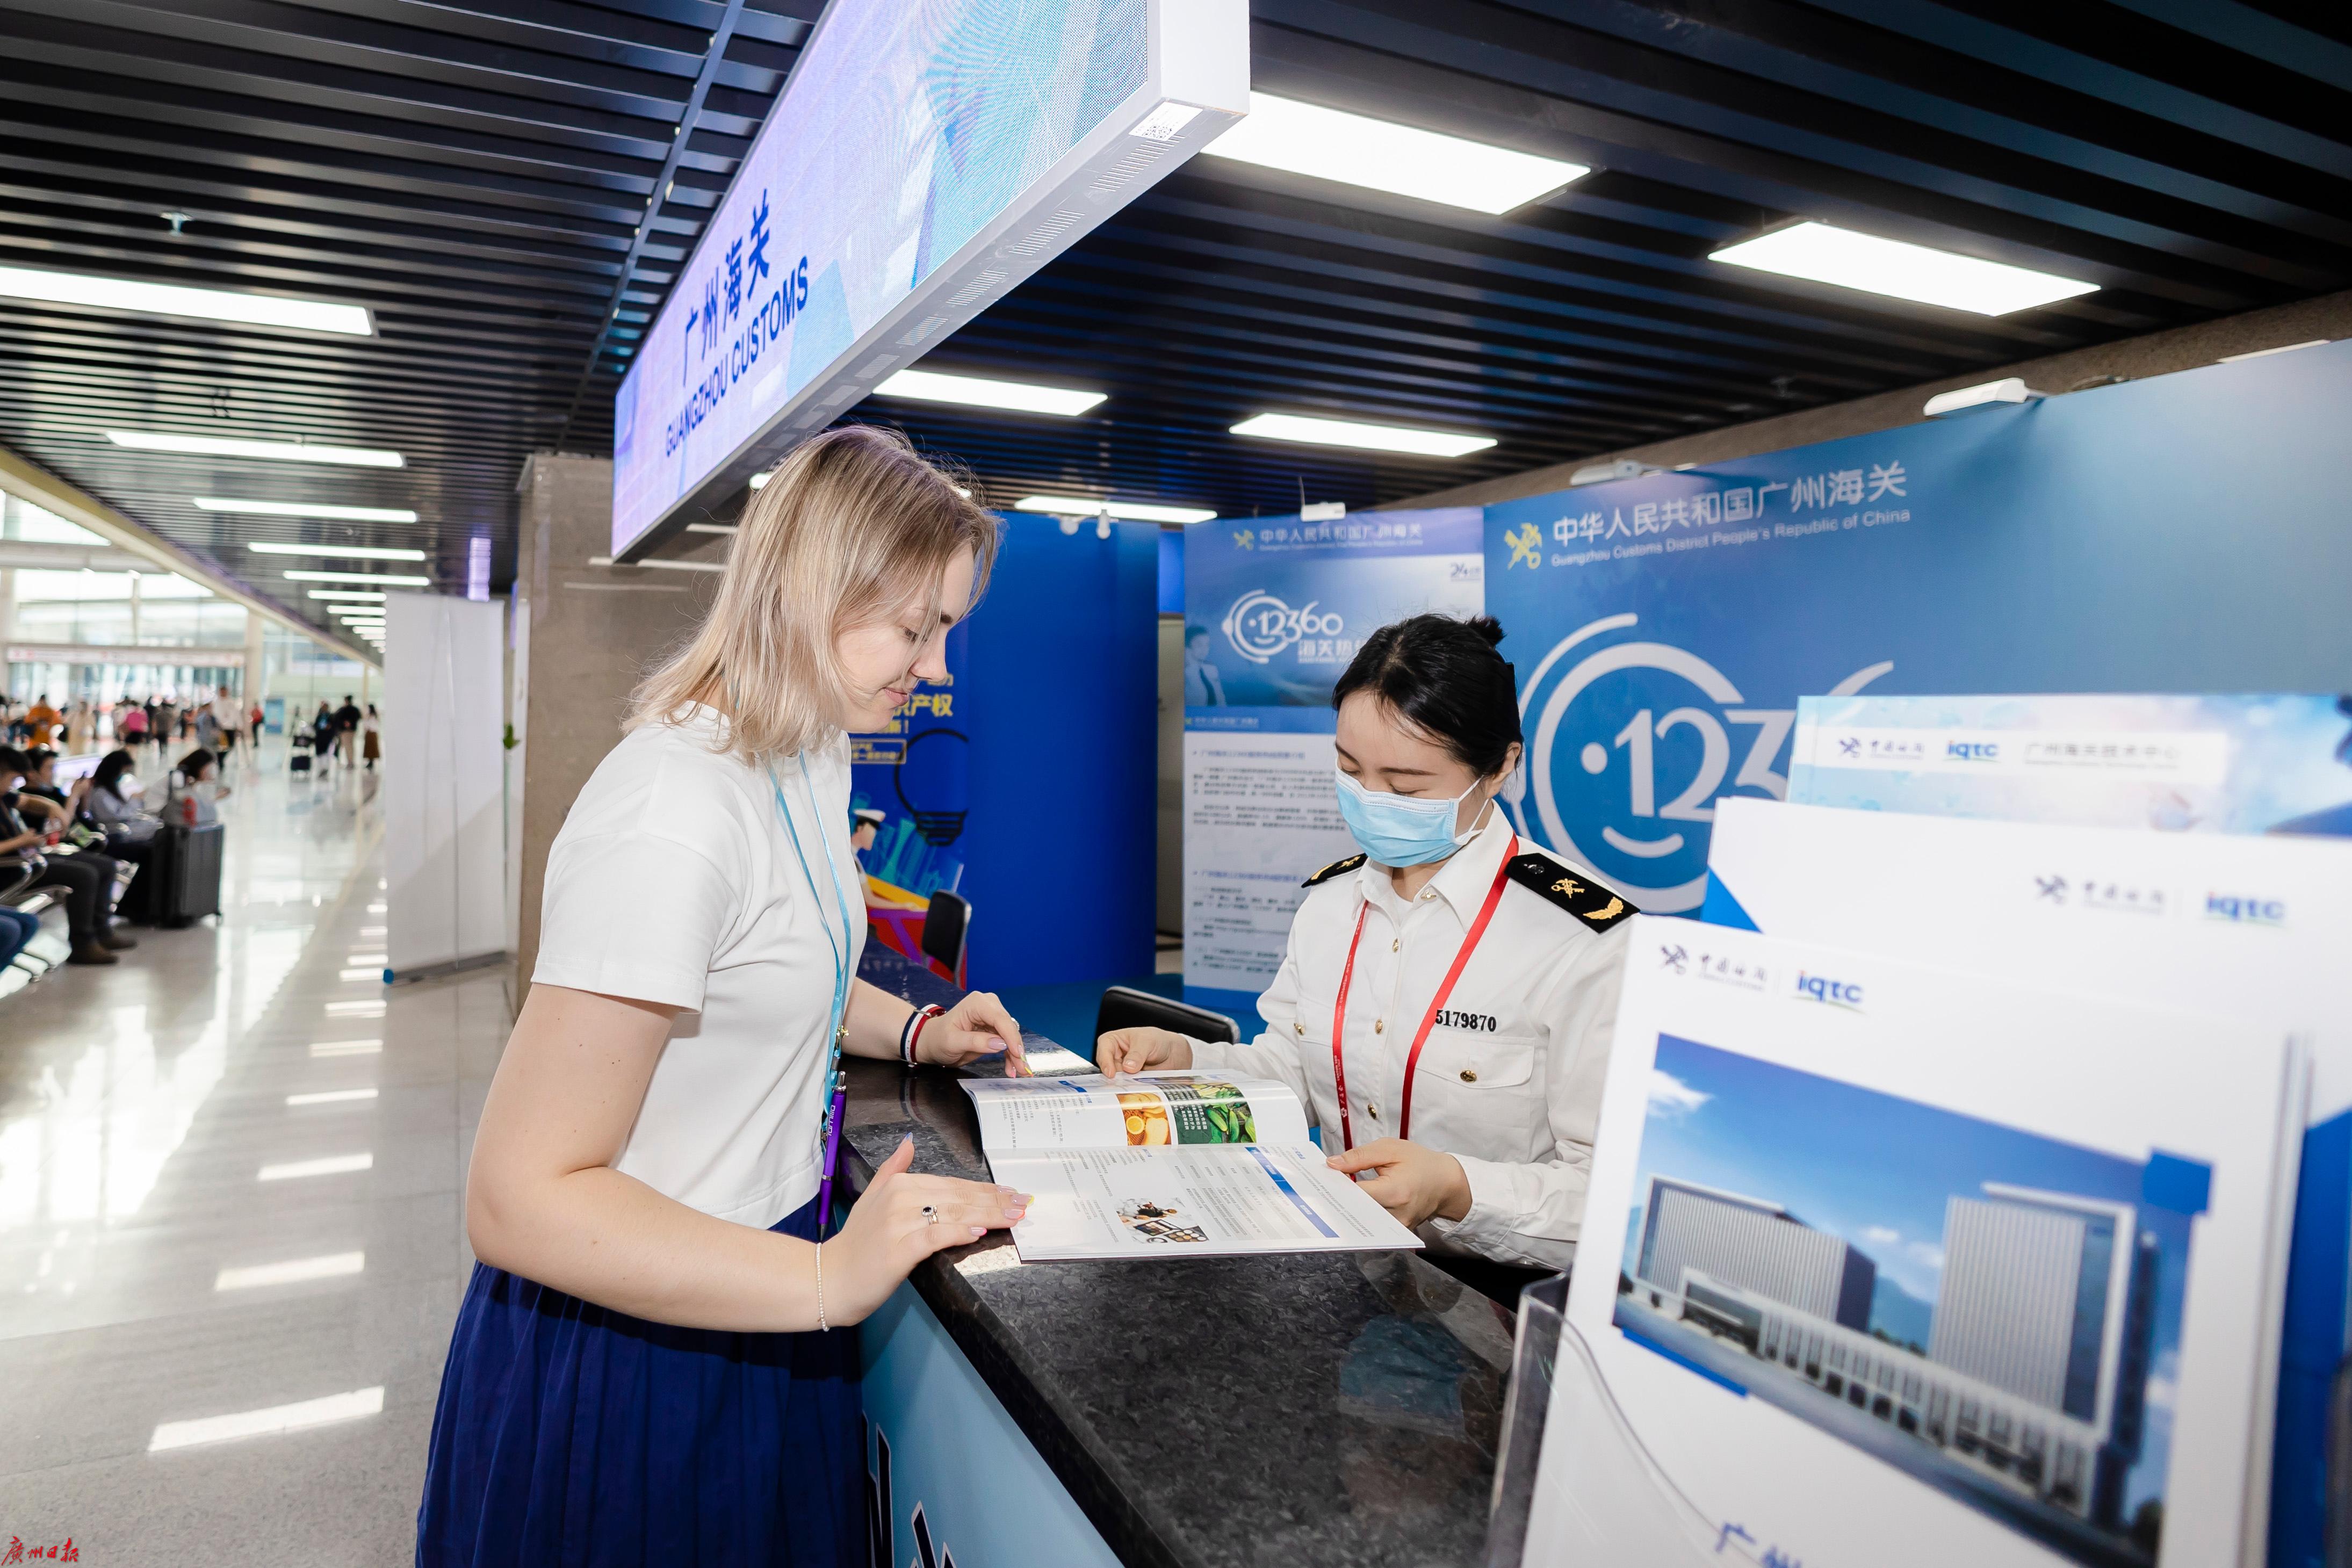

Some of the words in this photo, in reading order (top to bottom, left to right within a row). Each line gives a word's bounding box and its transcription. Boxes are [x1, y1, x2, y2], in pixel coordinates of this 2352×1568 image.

[683, 188, 770, 387] 广州海关
[666, 353, 729, 458] GUANGZHOU
[732, 255, 808, 384] CUSTOMS
[1553, 460, 1907, 547] 中华人民共和国广州海关
[1551, 549, 1611, 567] Guangzhou
[1613, 543, 1663, 559] Customs
[1666, 535, 1709, 553] District
[1774, 517, 1839, 538] Republic
[1842, 512, 1858, 529] of
[1862, 508, 1911, 528] China
[1258, 600, 1344, 643] 12360
[1948, 739, 1999, 760] iqtc
[2207, 891, 2285, 921] iqtc
[1797, 969, 1864, 1002] iqtc
[1435, 1009, 1497, 1032] 5179870
